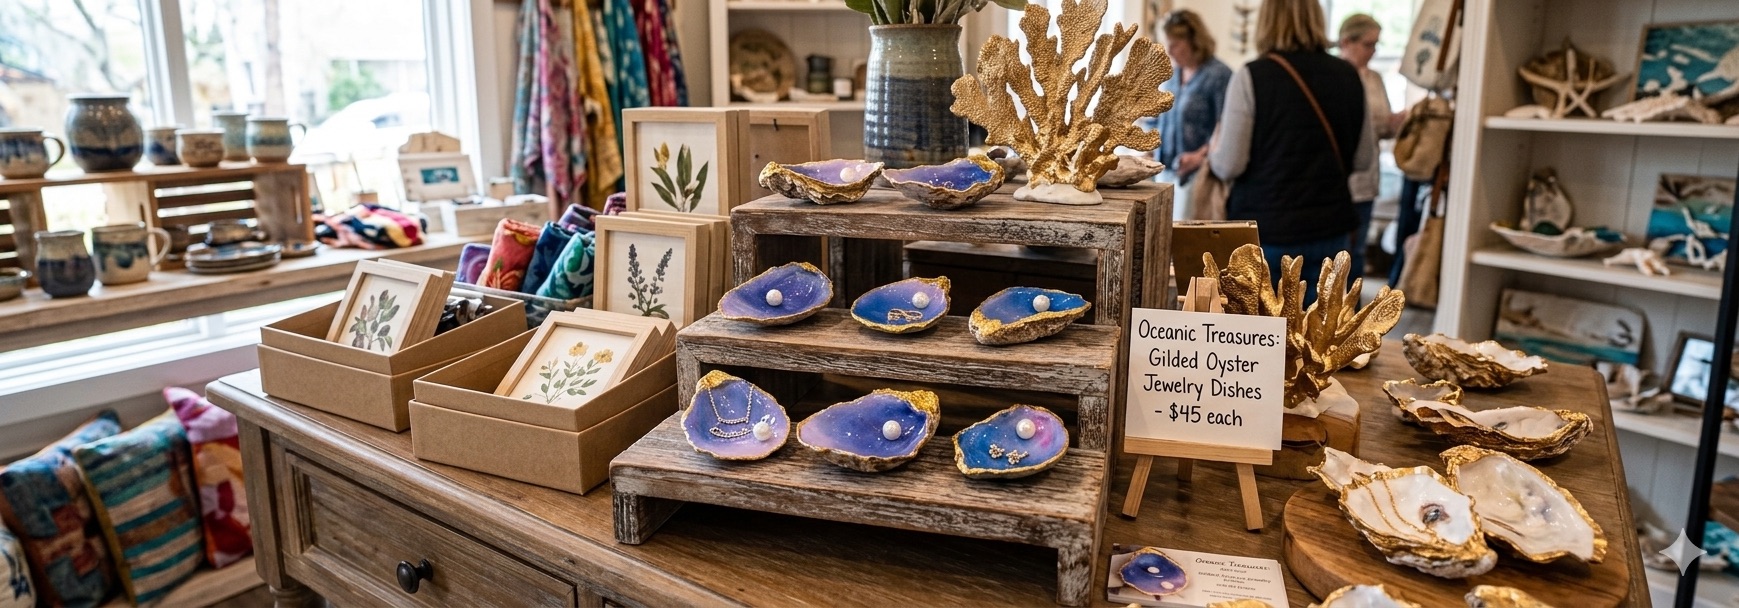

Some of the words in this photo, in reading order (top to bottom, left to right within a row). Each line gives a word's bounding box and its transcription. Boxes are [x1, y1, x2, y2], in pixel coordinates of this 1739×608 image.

[1138, 318, 1197, 342] Oceanic
[1202, 323, 1280, 347] Treasures:
[1149, 347, 1198, 370] Gilded
[1206, 352, 1259, 378] Oyster
[1143, 373, 1204, 401] Jewelry
[1211, 378, 1262, 400] Dishes
[1169, 402, 1201, 422] $45
[1207, 409, 1243, 427] each
